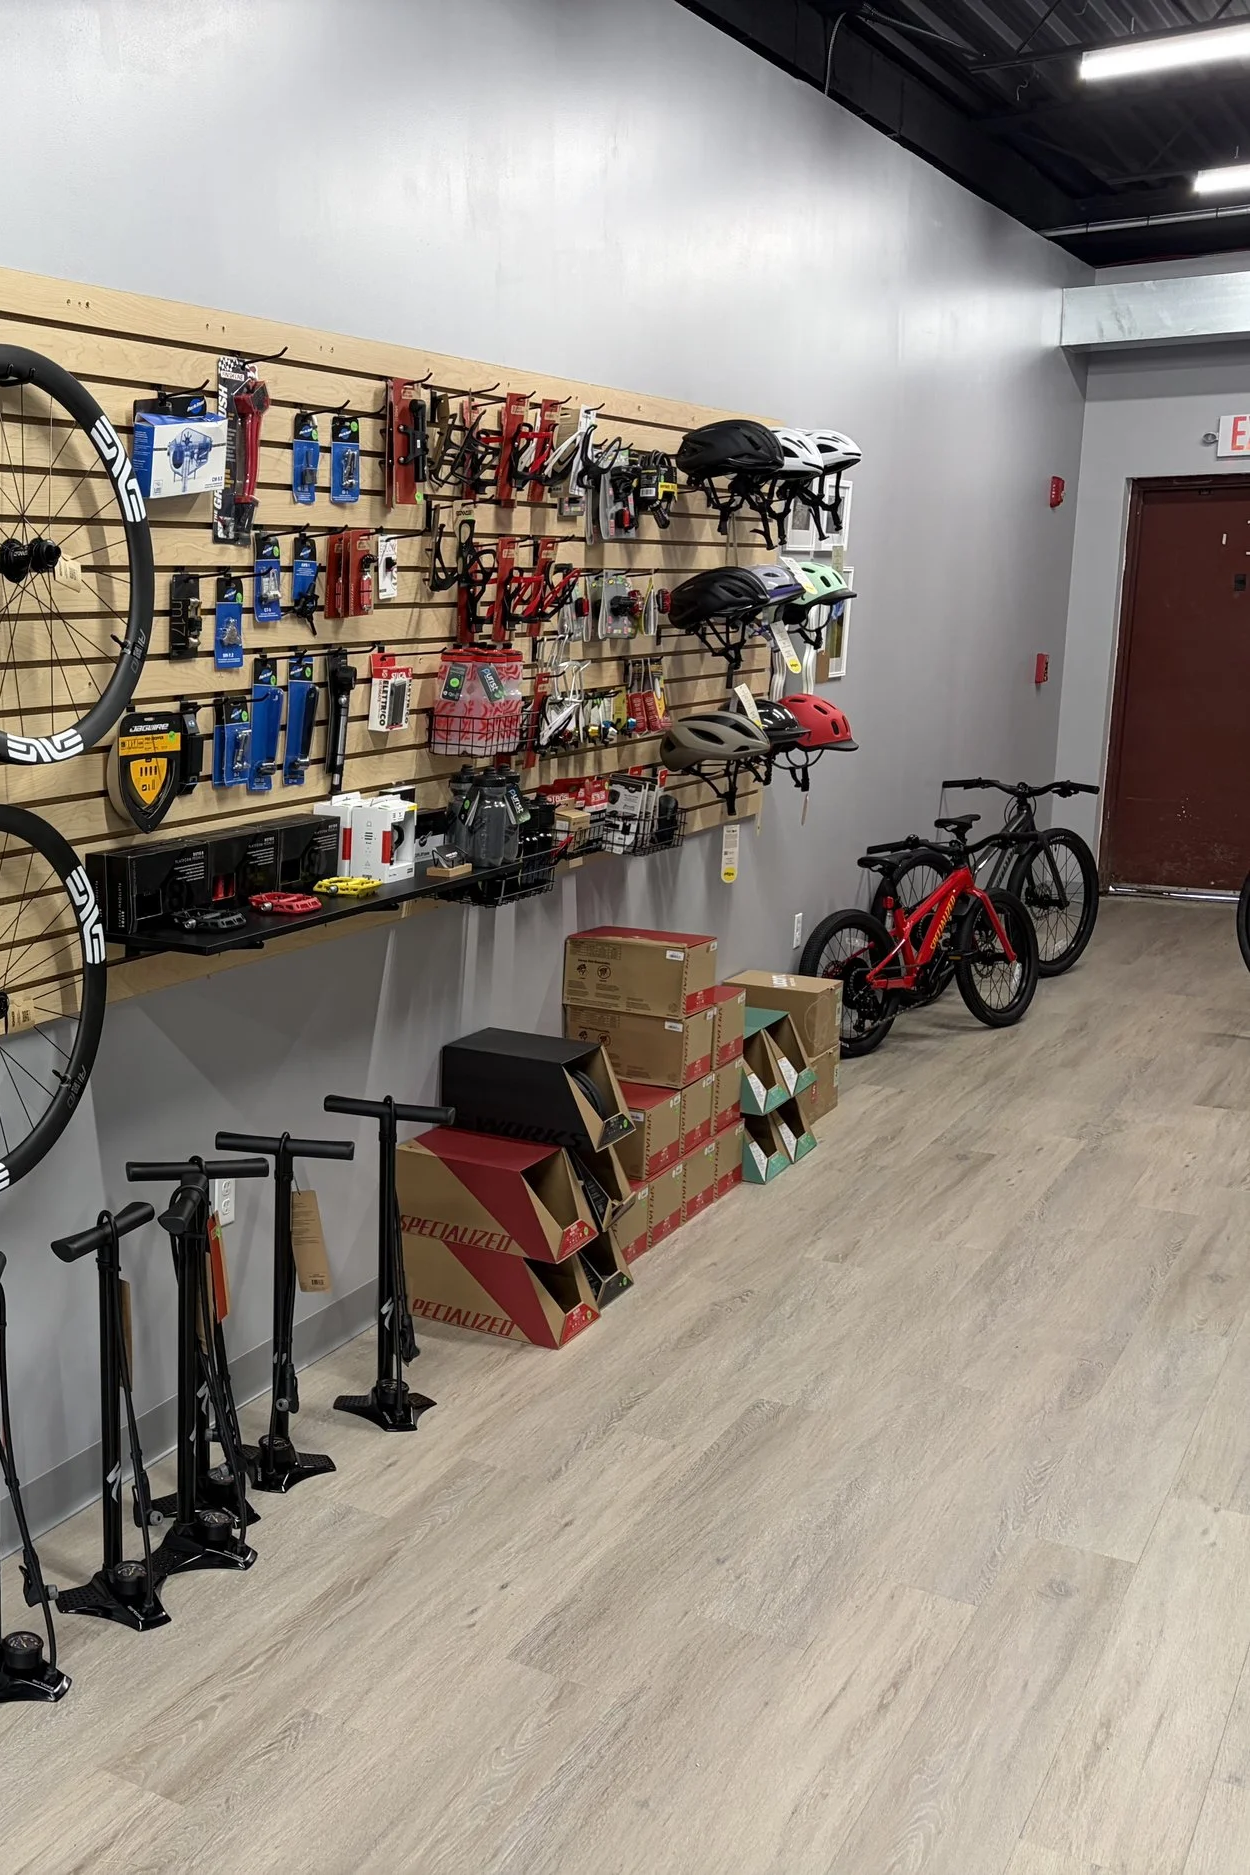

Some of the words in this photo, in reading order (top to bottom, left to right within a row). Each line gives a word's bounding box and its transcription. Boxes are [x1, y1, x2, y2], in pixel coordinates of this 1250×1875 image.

[1231, 415, 1250, 451] E
[379, 680, 389, 726] ELETTRICO
[400, 1214, 514, 1252] SPECIALIZED
[412, 1298, 517, 1337] PECIALIZED
